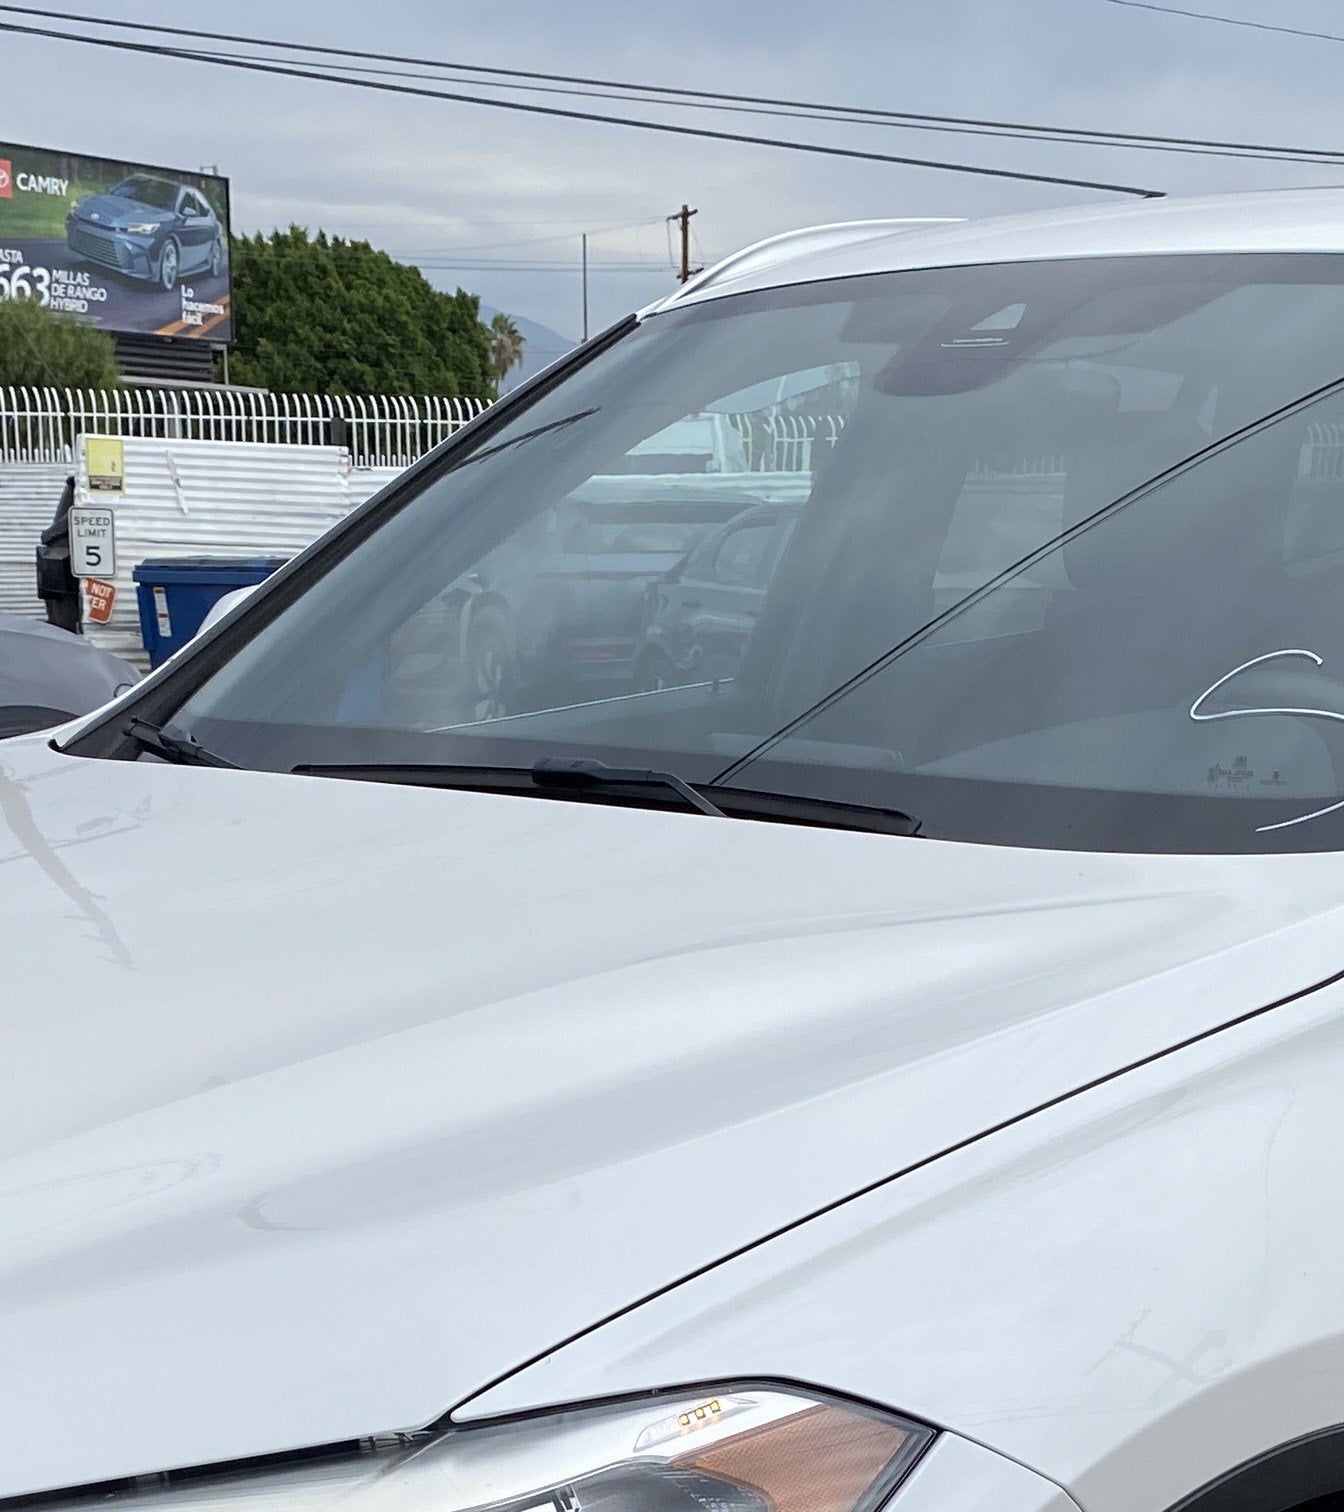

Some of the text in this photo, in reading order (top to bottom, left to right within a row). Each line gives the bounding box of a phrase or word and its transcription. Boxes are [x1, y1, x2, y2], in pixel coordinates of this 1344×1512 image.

[16, 172, 68, 196] CAMRY
[52, 269, 90, 286] MILLAS
[51, 283, 107, 302] DE RANGO
[181, 284, 194, 298] Lo
[50, 296, 88, 313] HYBRID
[74, 516, 111, 527] SPEED
[77, 529, 107, 538] LIMIT
[86, 546, 102, 567] 5
[90, 582, 113, 599] NOT
